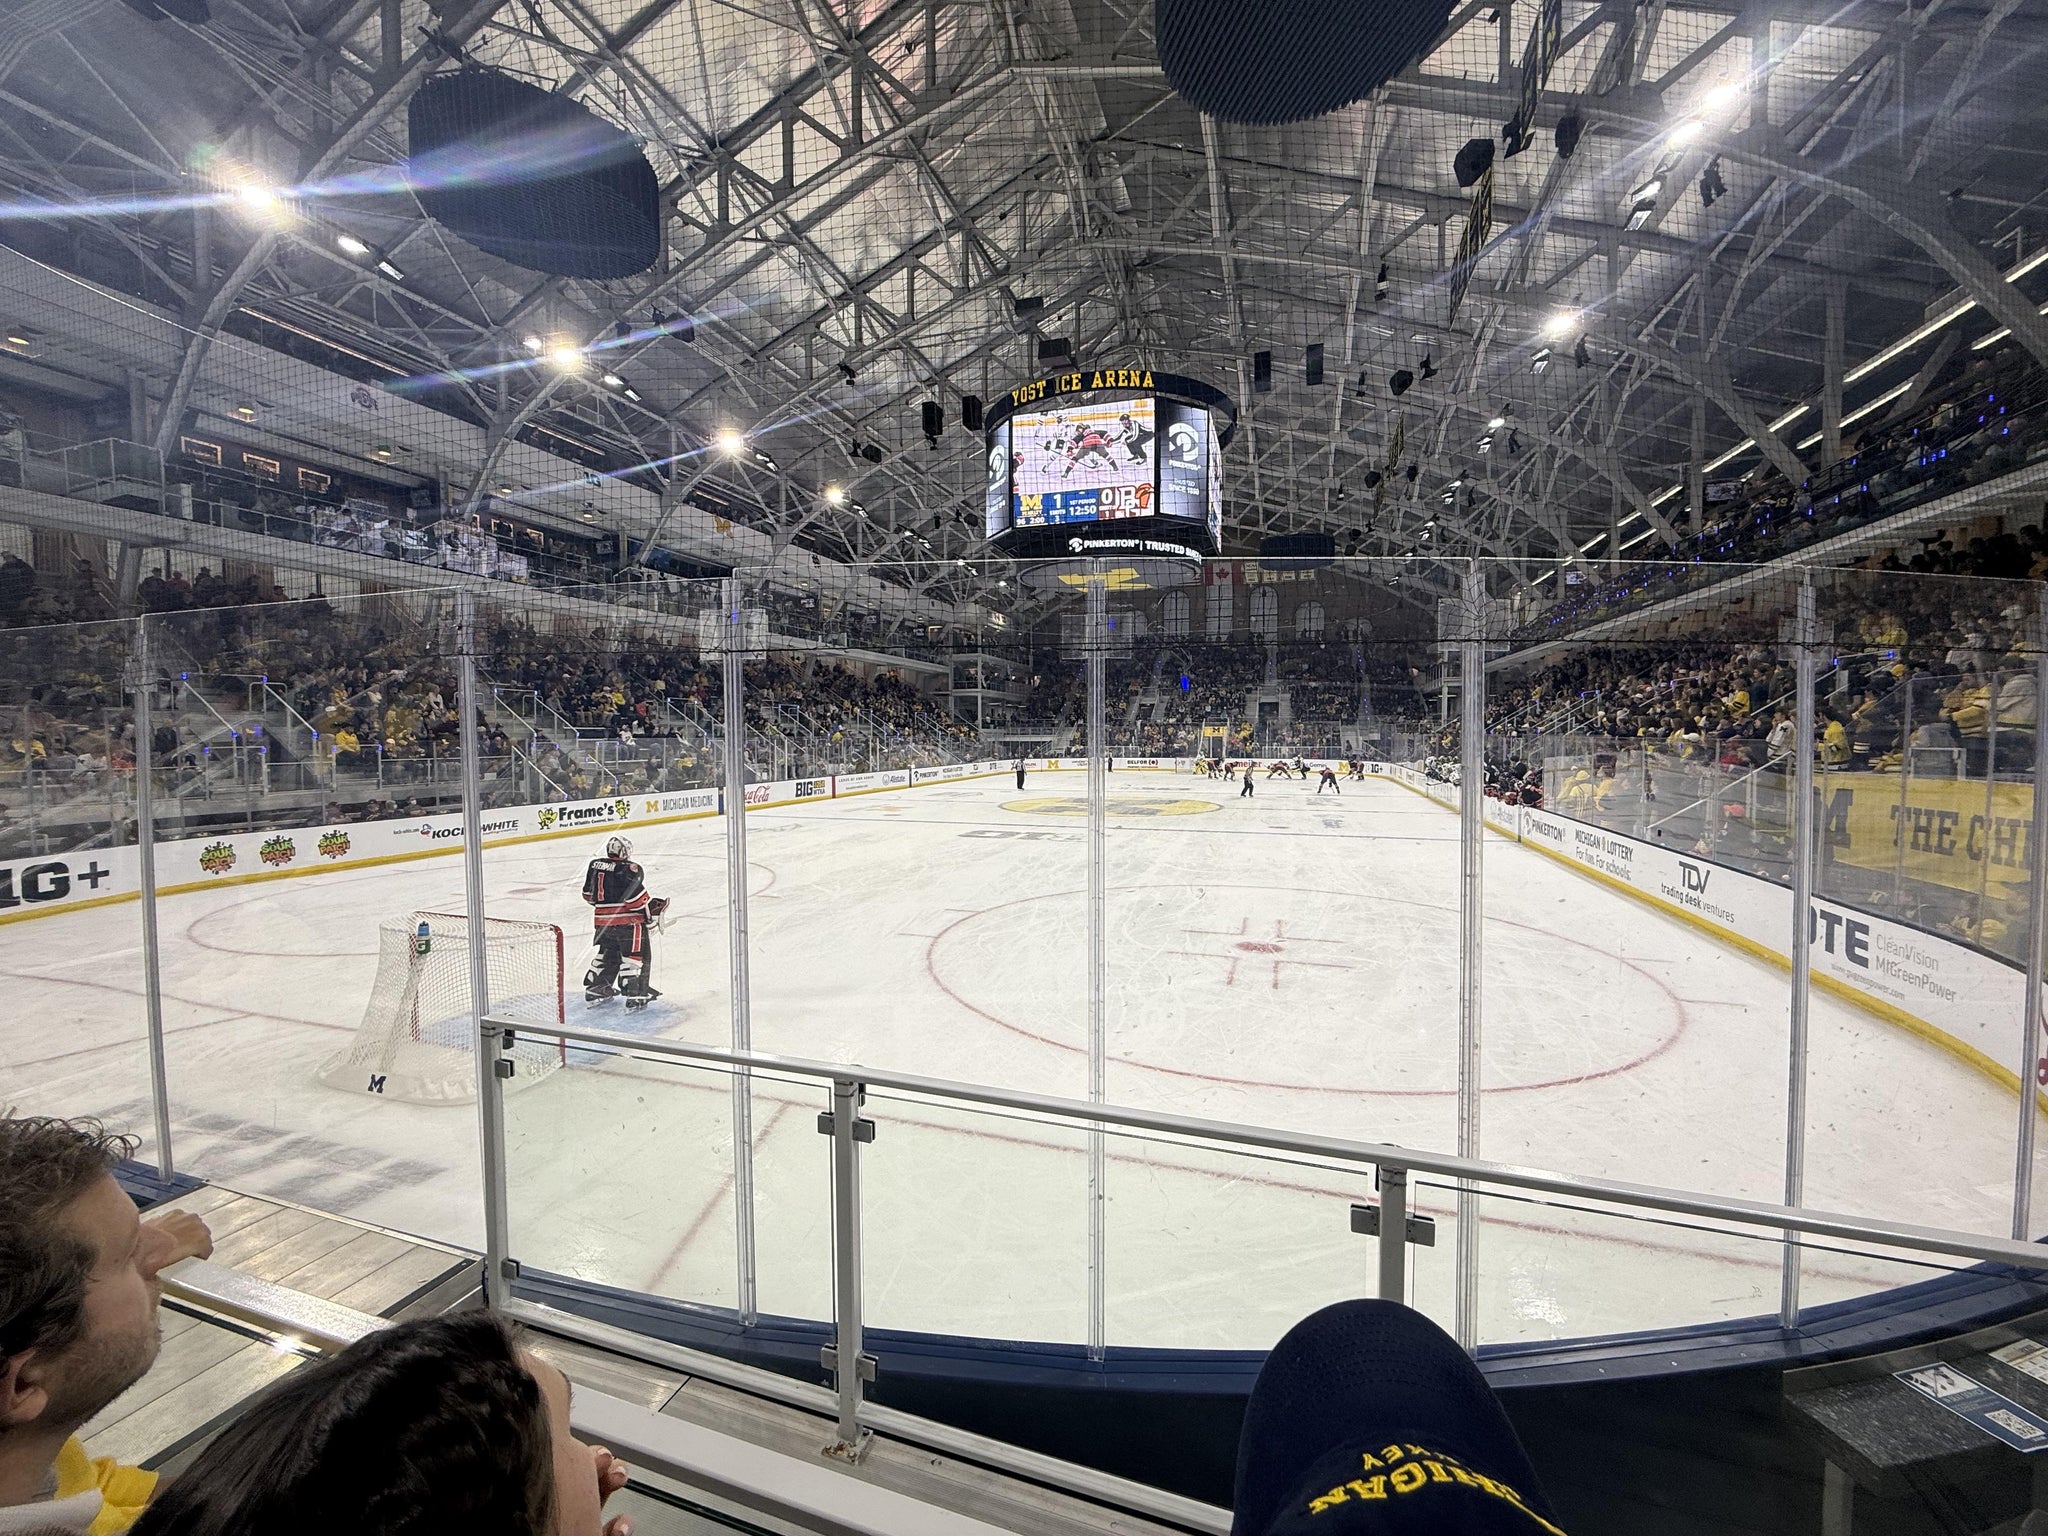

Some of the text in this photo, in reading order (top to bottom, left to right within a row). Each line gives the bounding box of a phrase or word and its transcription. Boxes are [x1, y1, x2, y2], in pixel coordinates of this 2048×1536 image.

[1012, 370, 1154, 406] YOST ICE ARENA
[1020, 494, 1043, 511] M
[1053, 494, 1061, 509] 1
[1101, 488, 1113, 505] 0
[1069, 505, 1097, 516] 12:50
[1029, 516, 1045, 524] 2:00
[1145, 540, 1185, 555] TRUSTED
[1047, 760, 1060, 769] M
[1338, 762, 1350, 771] M
[795, 781, 813, 797] BIG
[646, 800, 659, 814] M
[663, 794, 714, 811] MICHIGAN MEDICINE
[558, 802, 615, 821] Frame's
[483, 819, 519, 832] WHITE
[1890, 804, 1959, 856] THE
[261, 841, 293, 853] SOUR
[319, 835, 348, 847] SOUR
[319, 842, 351, 855] PATCH
[1575, 829, 1634, 862] MICHIGAN LOTTERY
[202, 847, 233, 861] SOUR
[202, 854, 236, 870] PATCH
[262, 849, 296, 862] PATCH
[1576, 846, 1584, 860] For
[1596, 855, 1606, 869] For
[1679, 861, 1711, 894] TDV
[597, 872, 605, 901] 1
[1661, 882, 1735, 923] trading desk ventures
[1876, 934, 1939, 972] CleanVision
[368, 1073, 387, 1094] M
